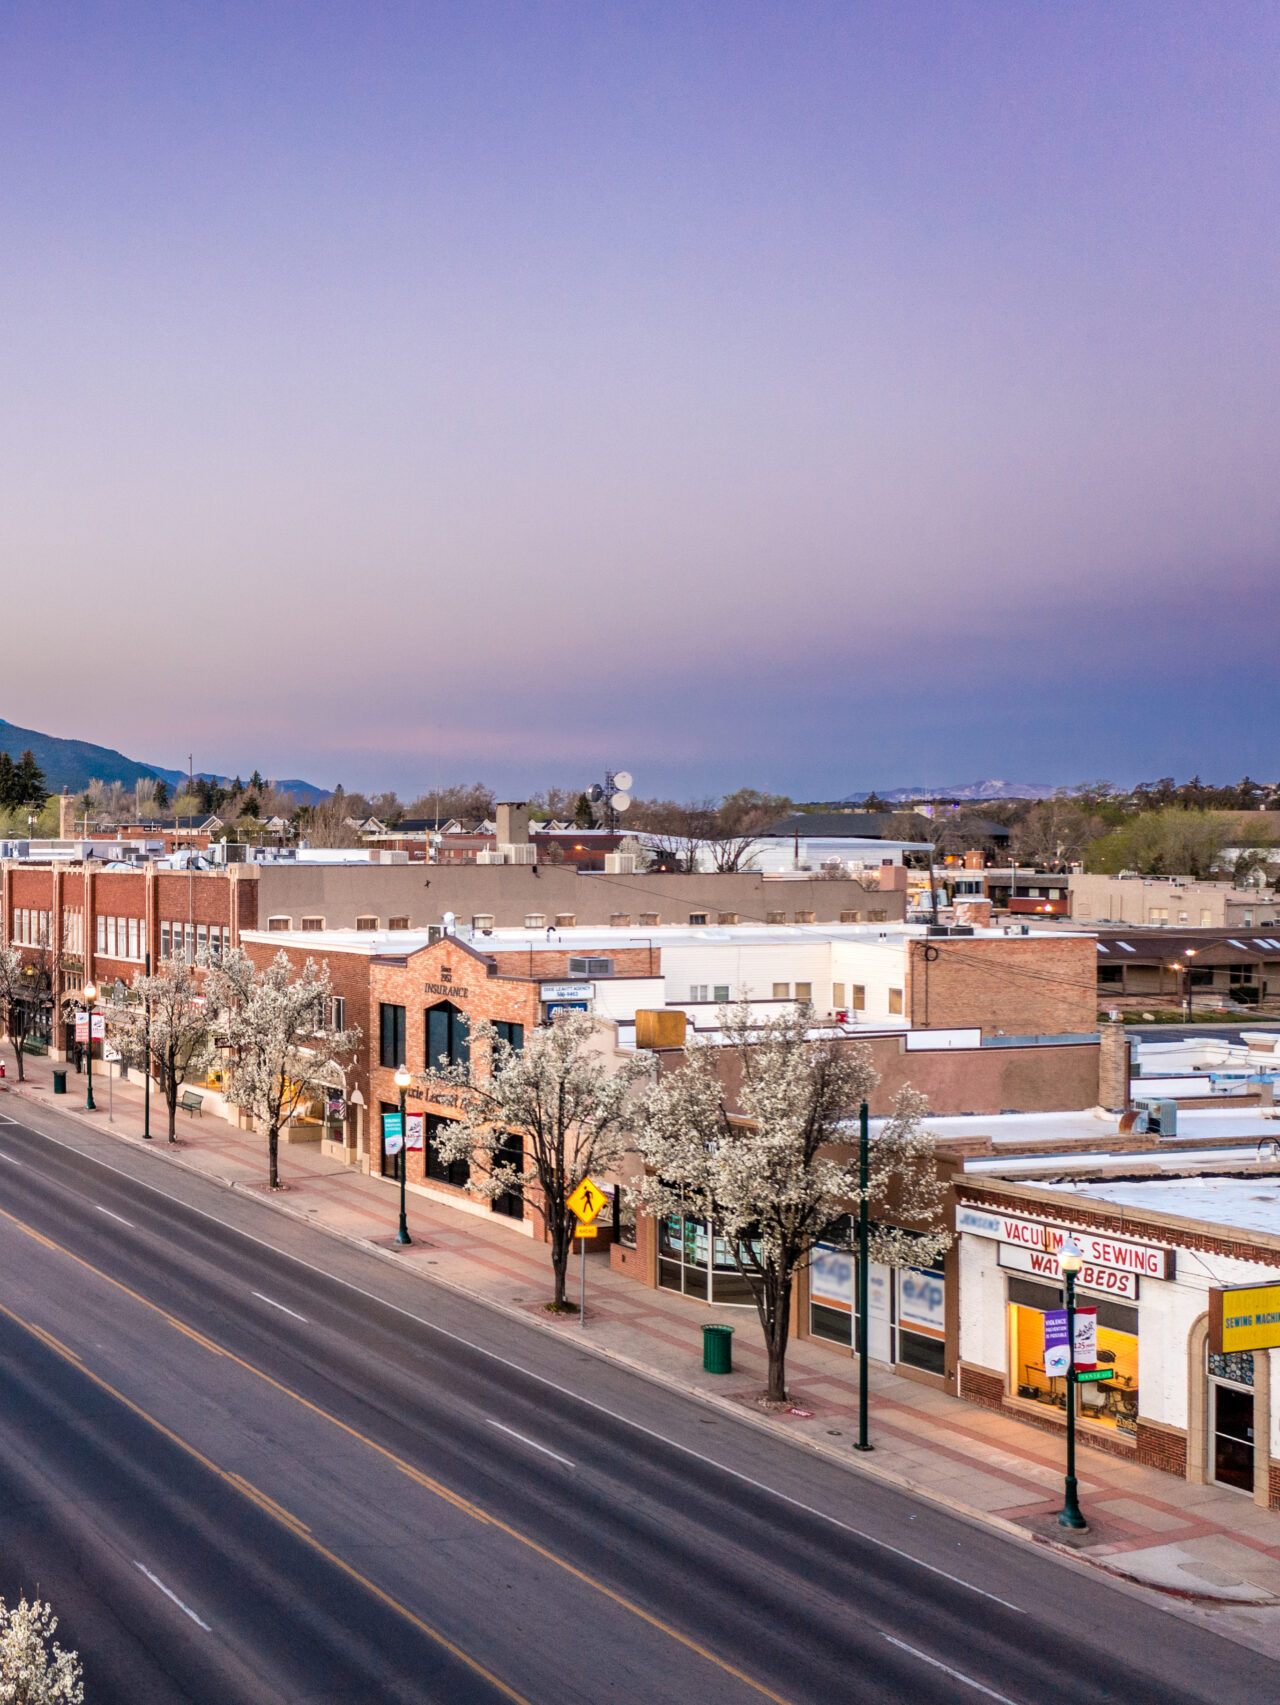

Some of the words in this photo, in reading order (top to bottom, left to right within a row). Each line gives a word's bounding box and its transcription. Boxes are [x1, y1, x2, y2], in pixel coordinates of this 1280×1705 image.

[425, 983, 468, 998] INSURANCE
[1004, 1221, 1064, 1249] VACUUM
[1092, 1241, 1158, 1273] SEWING
[1030, 1253, 1129, 1292] WATRBEDS
[1045, 1318, 1066, 1326] VIOLENCE
[1225, 1315, 1252, 1329] SEWING
